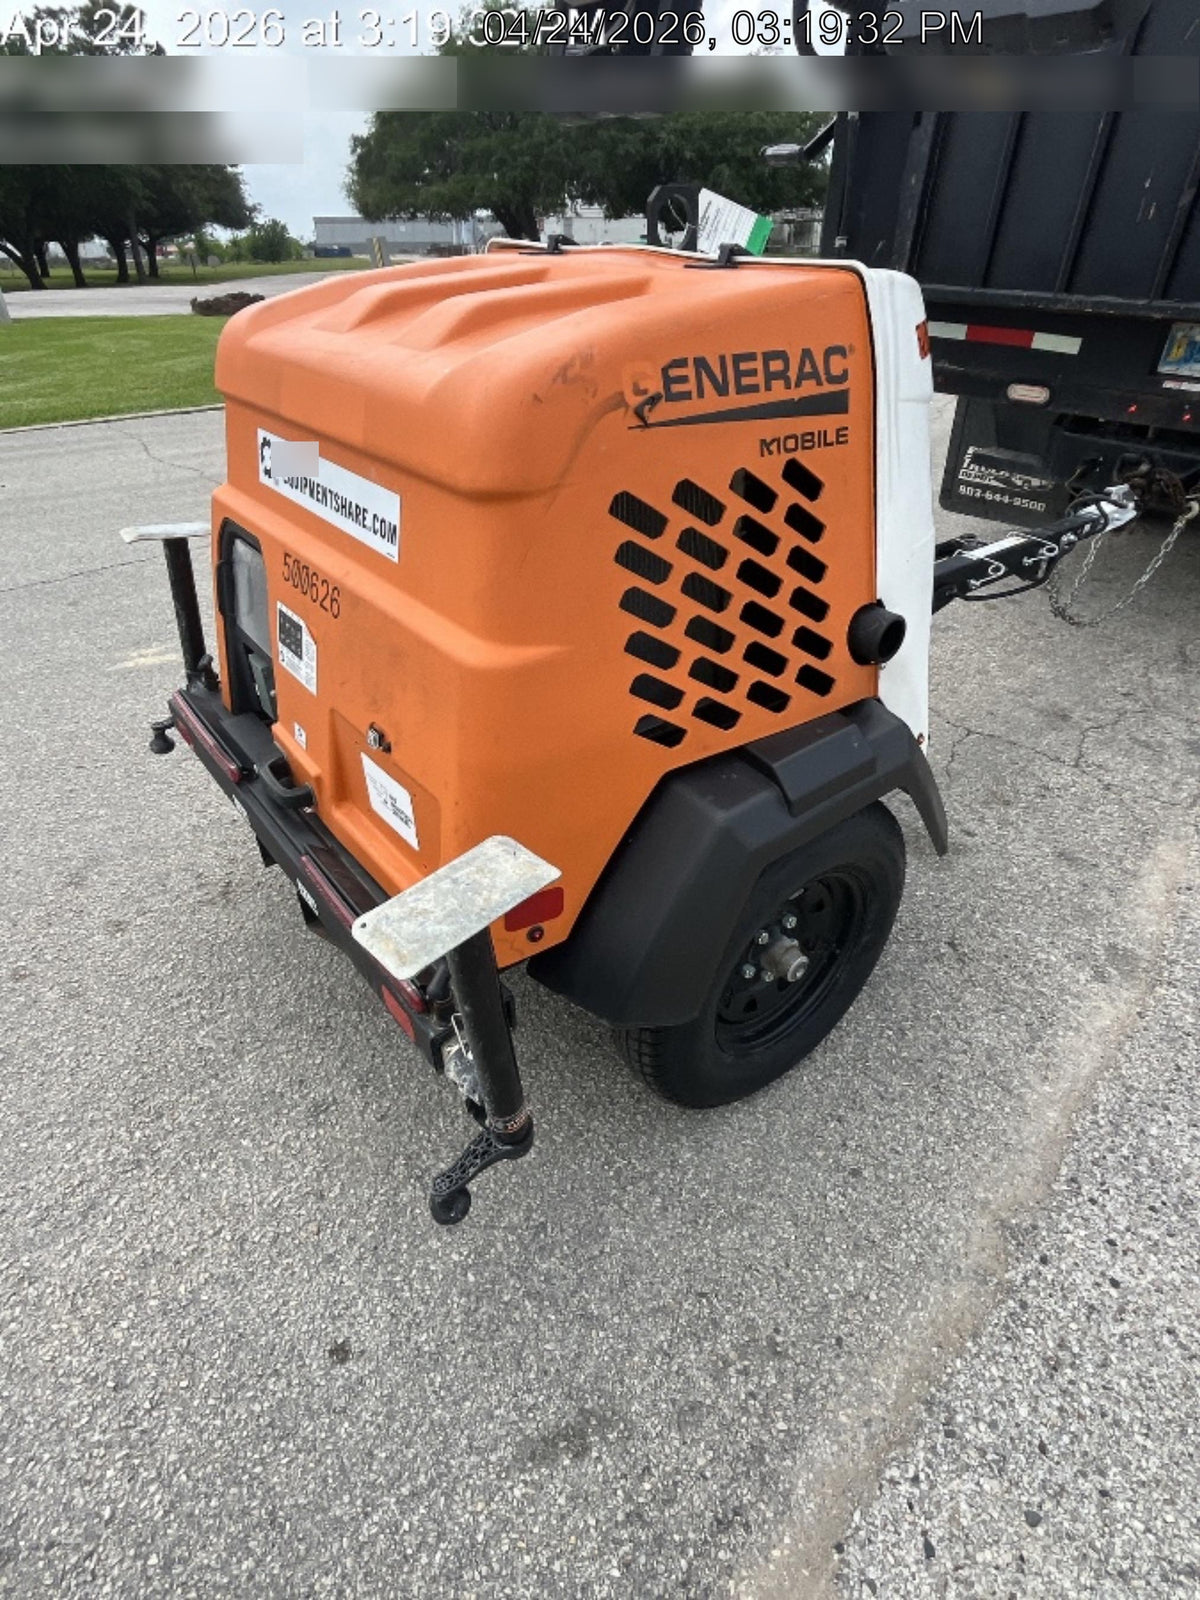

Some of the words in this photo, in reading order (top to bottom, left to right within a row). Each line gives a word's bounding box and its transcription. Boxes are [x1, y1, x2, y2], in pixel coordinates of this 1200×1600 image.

[626, 345, 849, 403] ENERAC
[759, 426, 849, 457] MOBILE
[282, 552, 341, 619] 500626
